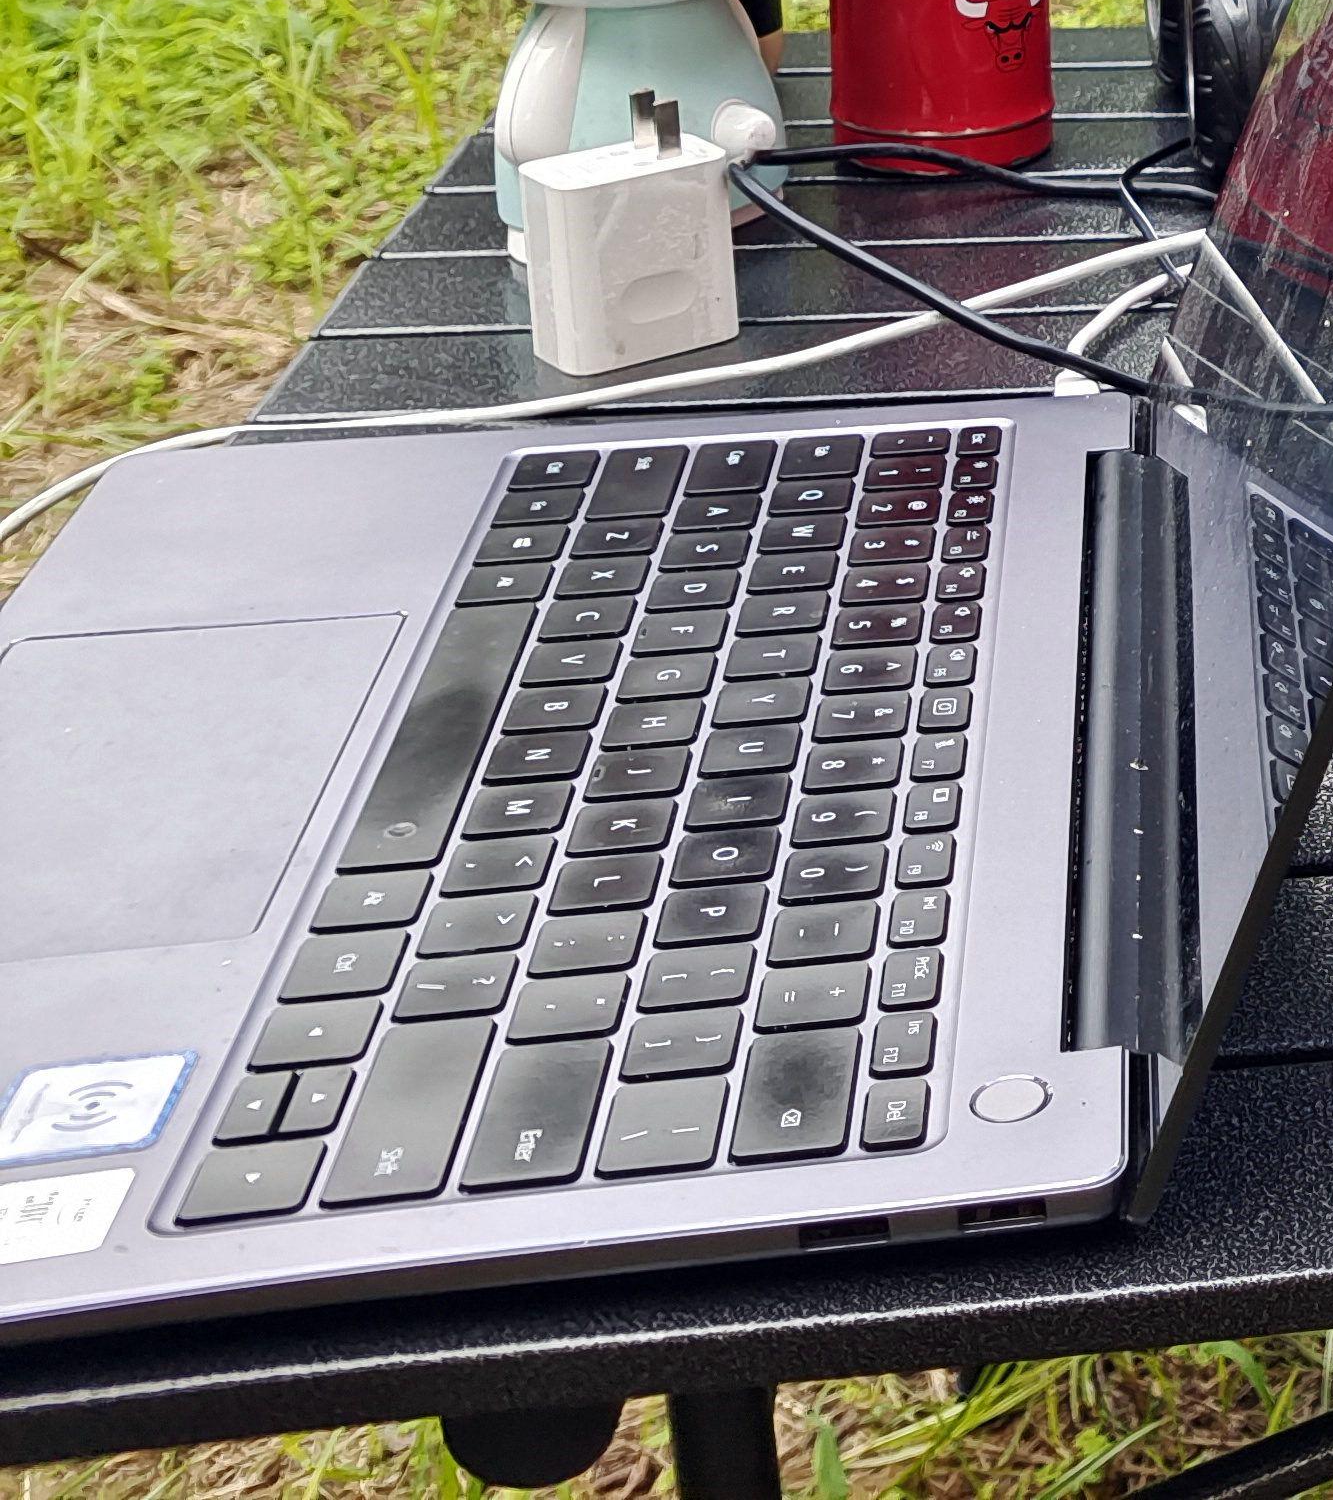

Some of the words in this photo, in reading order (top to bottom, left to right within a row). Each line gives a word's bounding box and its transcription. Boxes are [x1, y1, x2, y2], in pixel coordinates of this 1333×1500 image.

[798, 490, 824, 501] Q
[706, 507, 729, 516] A
[871, 504, 893, 512] 2
[791, 525, 815, 537] W
[606, 532, 629, 541] Z
[696, 544, 719, 552] S
[864, 541, 885, 549] 3
[591, 570, 615, 580] X
[782, 566, 805, 574] E
[684, 583, 707, 593] D
[856, 579, 878, 587] 4
[576, 611, 600, 621] C
[772, 606, 796, 616] R
[671, 626, 694, 634] F
[849, 621, 872, 629] 5
[763, 649, 786, 658] T
[561, 654, 585, 664] V
[840, 665, 863, 673] 6
[657, 670, 680, 680] G
[752, 694, 776, 703] Y
[544, 701, 570, 711] B
[641, 716, 667, 728] H
[739, 742, 764, 753] U
[523, 749, 551, 760] N
[822, 760, 846, 769] 8
[505, 800, 533, 814] M
[812, 812, 836, 822] 9
[611, 819, 637, 831] K
[712, 846, 738, 861] O
[800, 868, 825, 877] 0
[594, 875, 621, 887] L
[700, 906, 727, 916] P
[886, 1100, 907, 1124] Del
